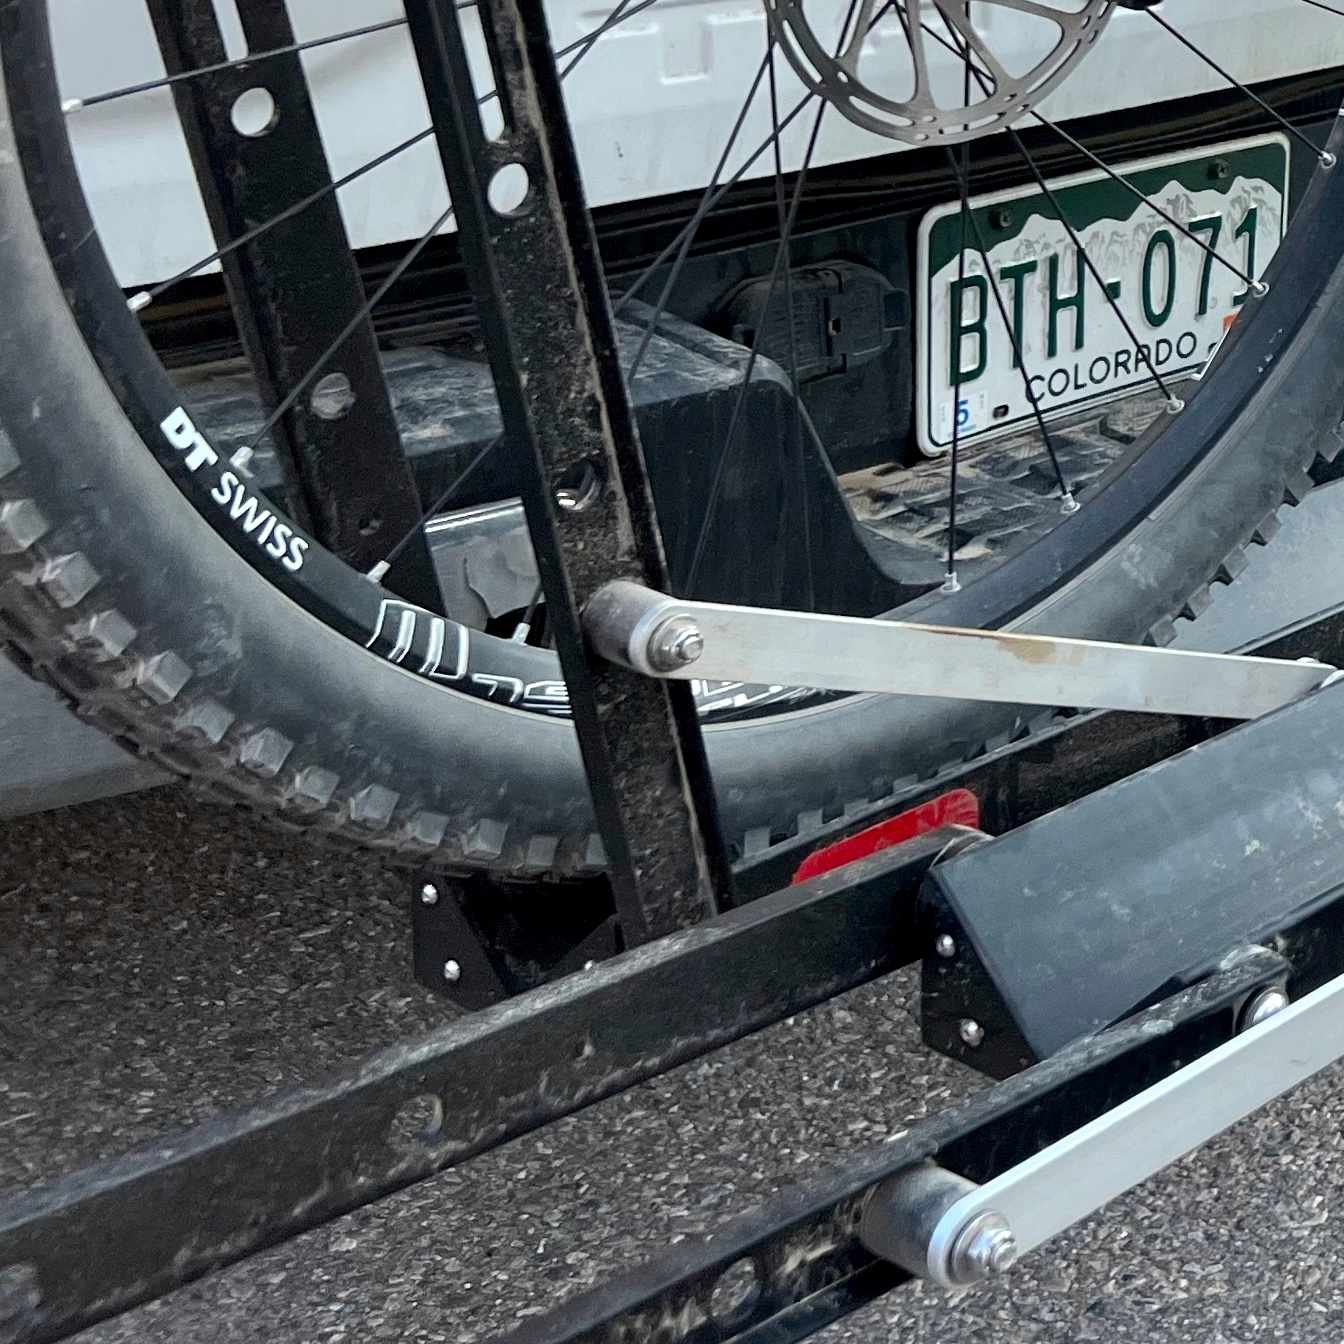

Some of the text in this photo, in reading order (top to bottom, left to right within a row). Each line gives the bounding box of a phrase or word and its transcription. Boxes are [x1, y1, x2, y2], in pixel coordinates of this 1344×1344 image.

[950, 206, 1259, 387] BTH-071
[1025, 331, 1198, 405] COLORADO
[159, 405, 309, 572] DT SWISS
